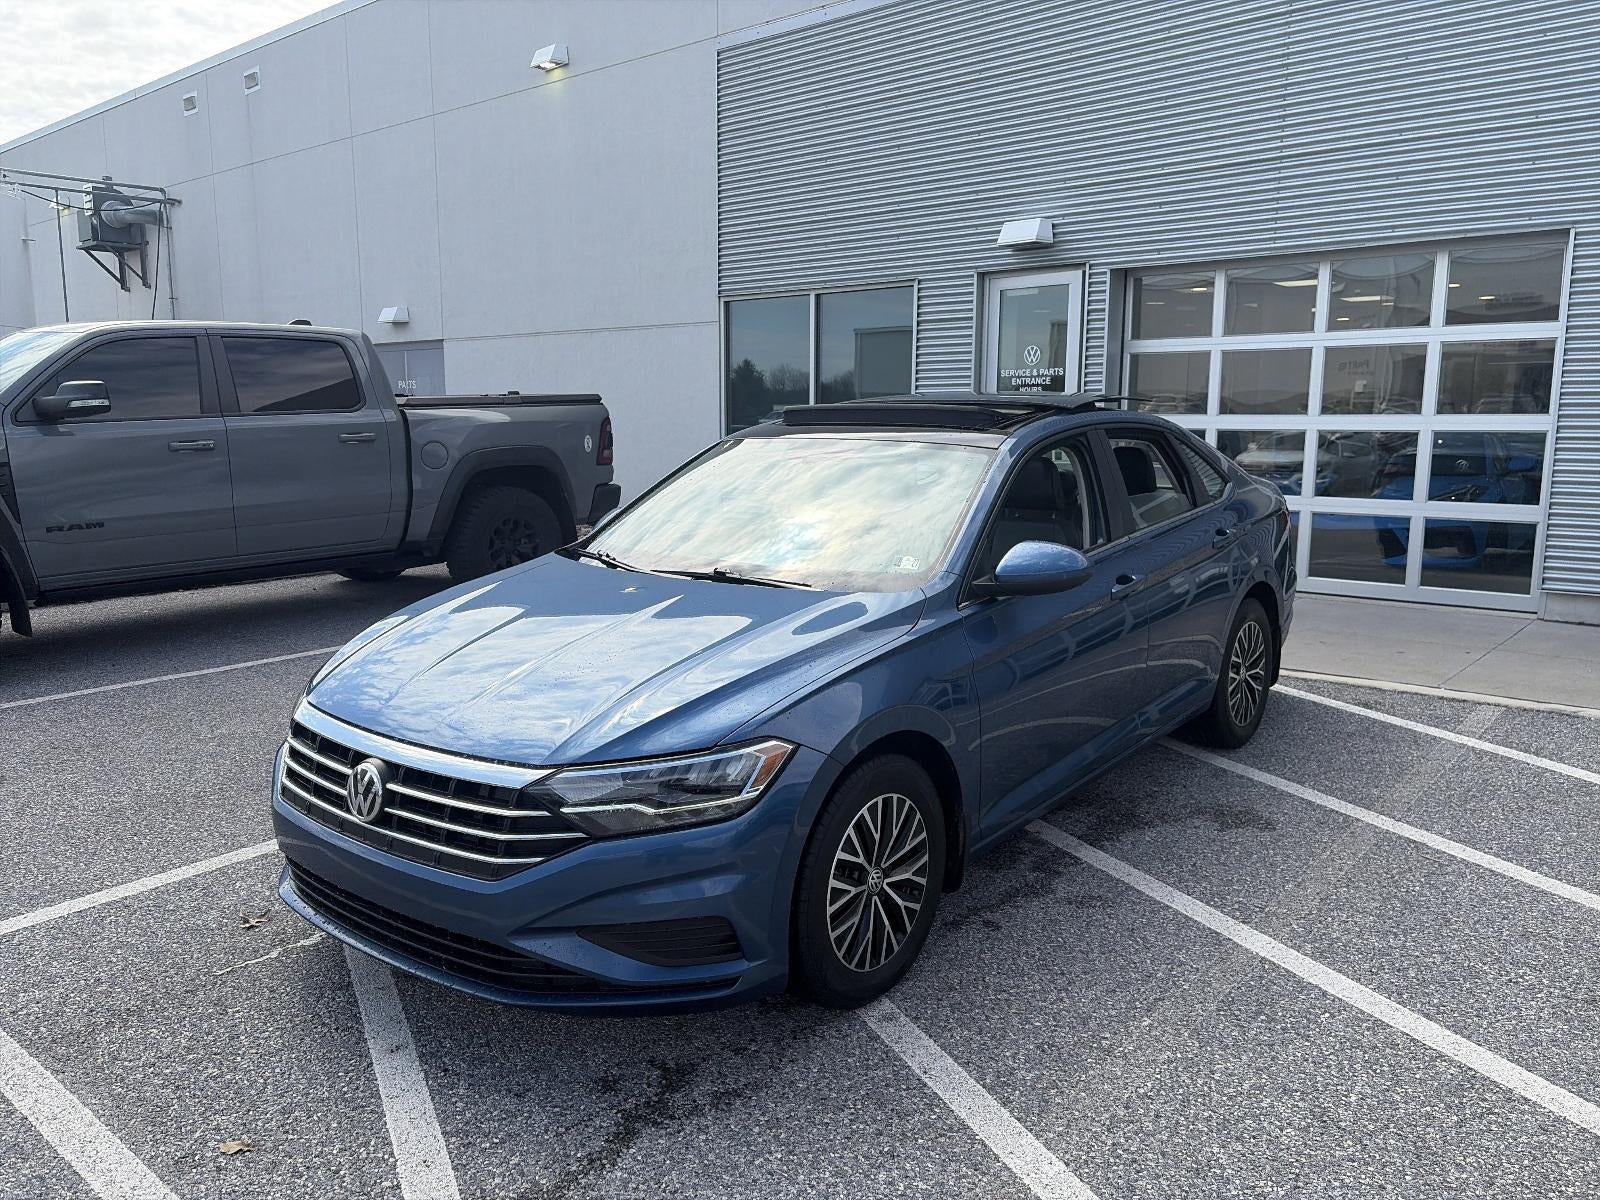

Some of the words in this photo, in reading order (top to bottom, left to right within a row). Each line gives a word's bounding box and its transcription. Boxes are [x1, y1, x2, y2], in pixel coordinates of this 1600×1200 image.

[1001, 369, 1031, 377] SERVICE
[1032, 368, 1038, 376] &
[1039, 368, 1064, 376] PARTS
[1011, 377, 1052, 386] ENTRANCE
[46, 522, 105, 533] RAM
